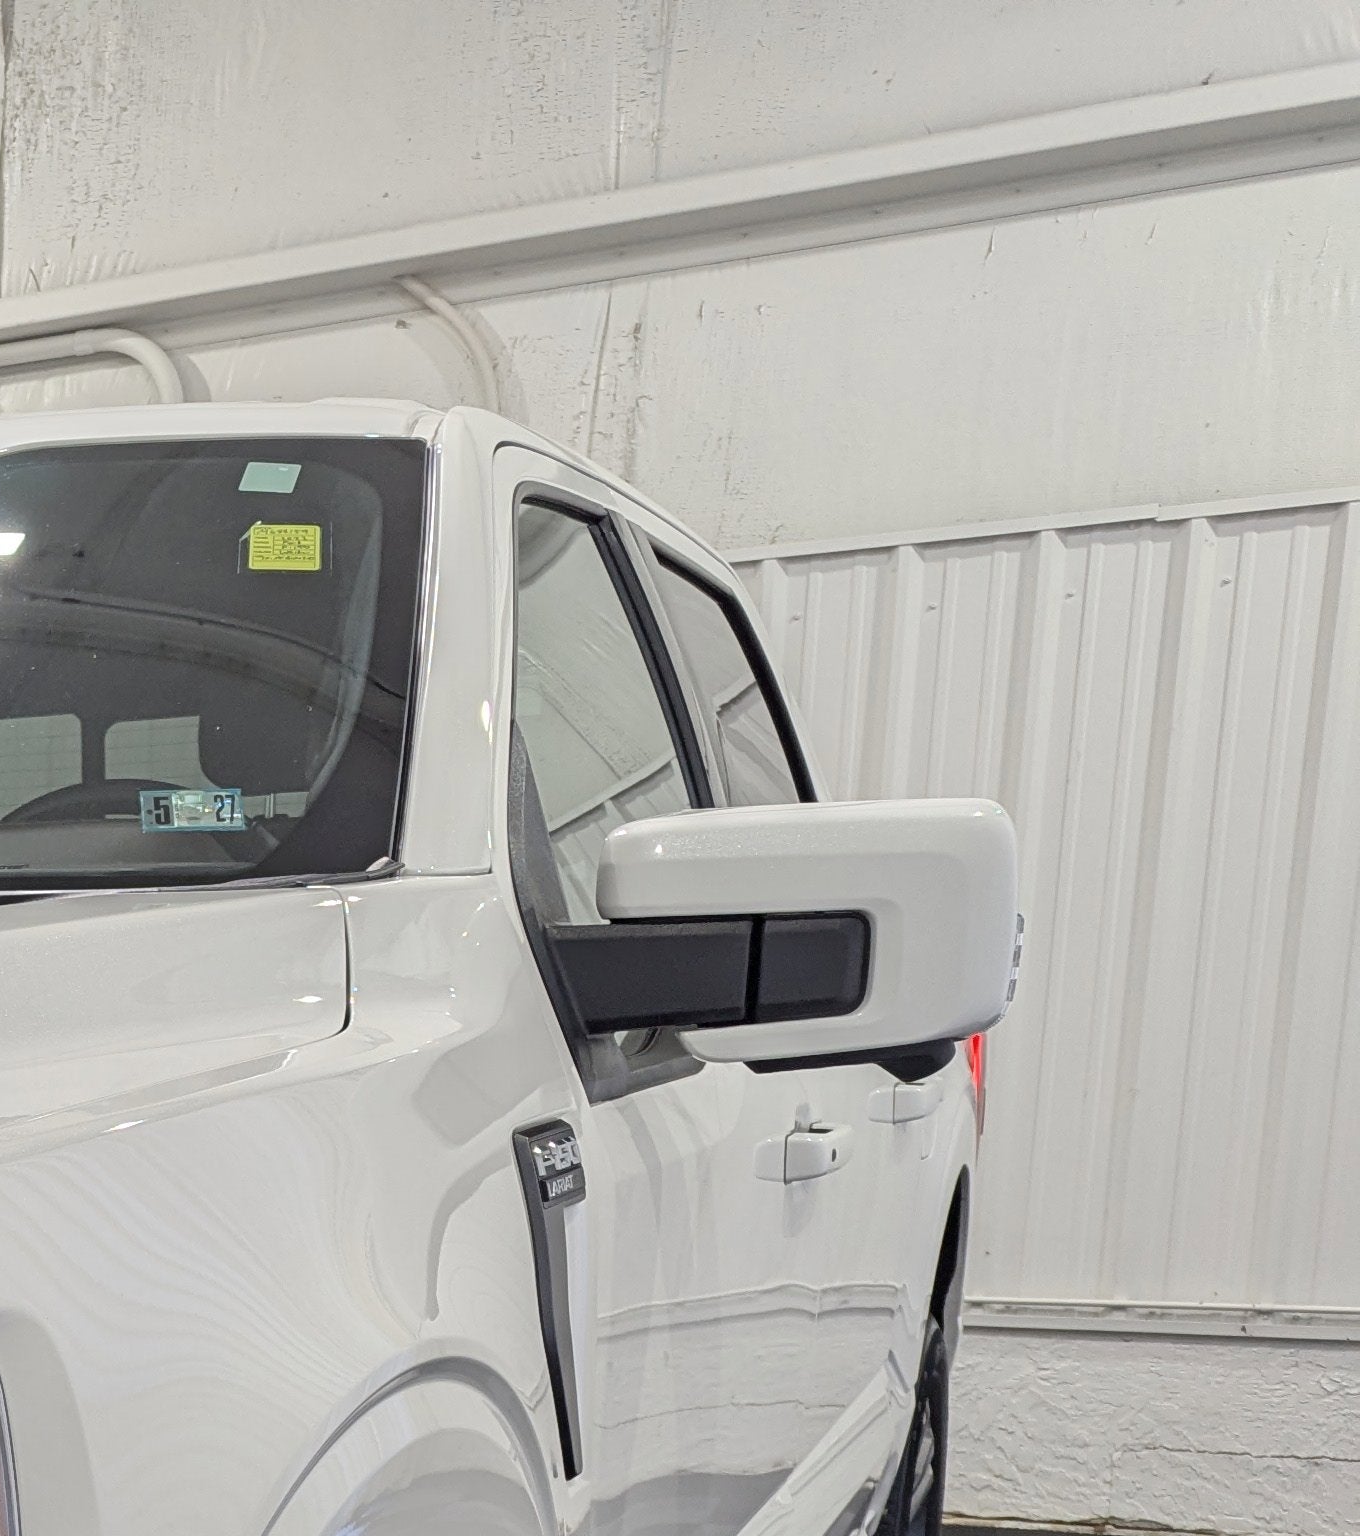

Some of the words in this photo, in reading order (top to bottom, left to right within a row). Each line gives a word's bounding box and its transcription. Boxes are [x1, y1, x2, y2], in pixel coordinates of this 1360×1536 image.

[153, 796, 171, 825] 5
[214, 794, 236, 825] 27
[545, 1174, 574, 1198] LARIAT
